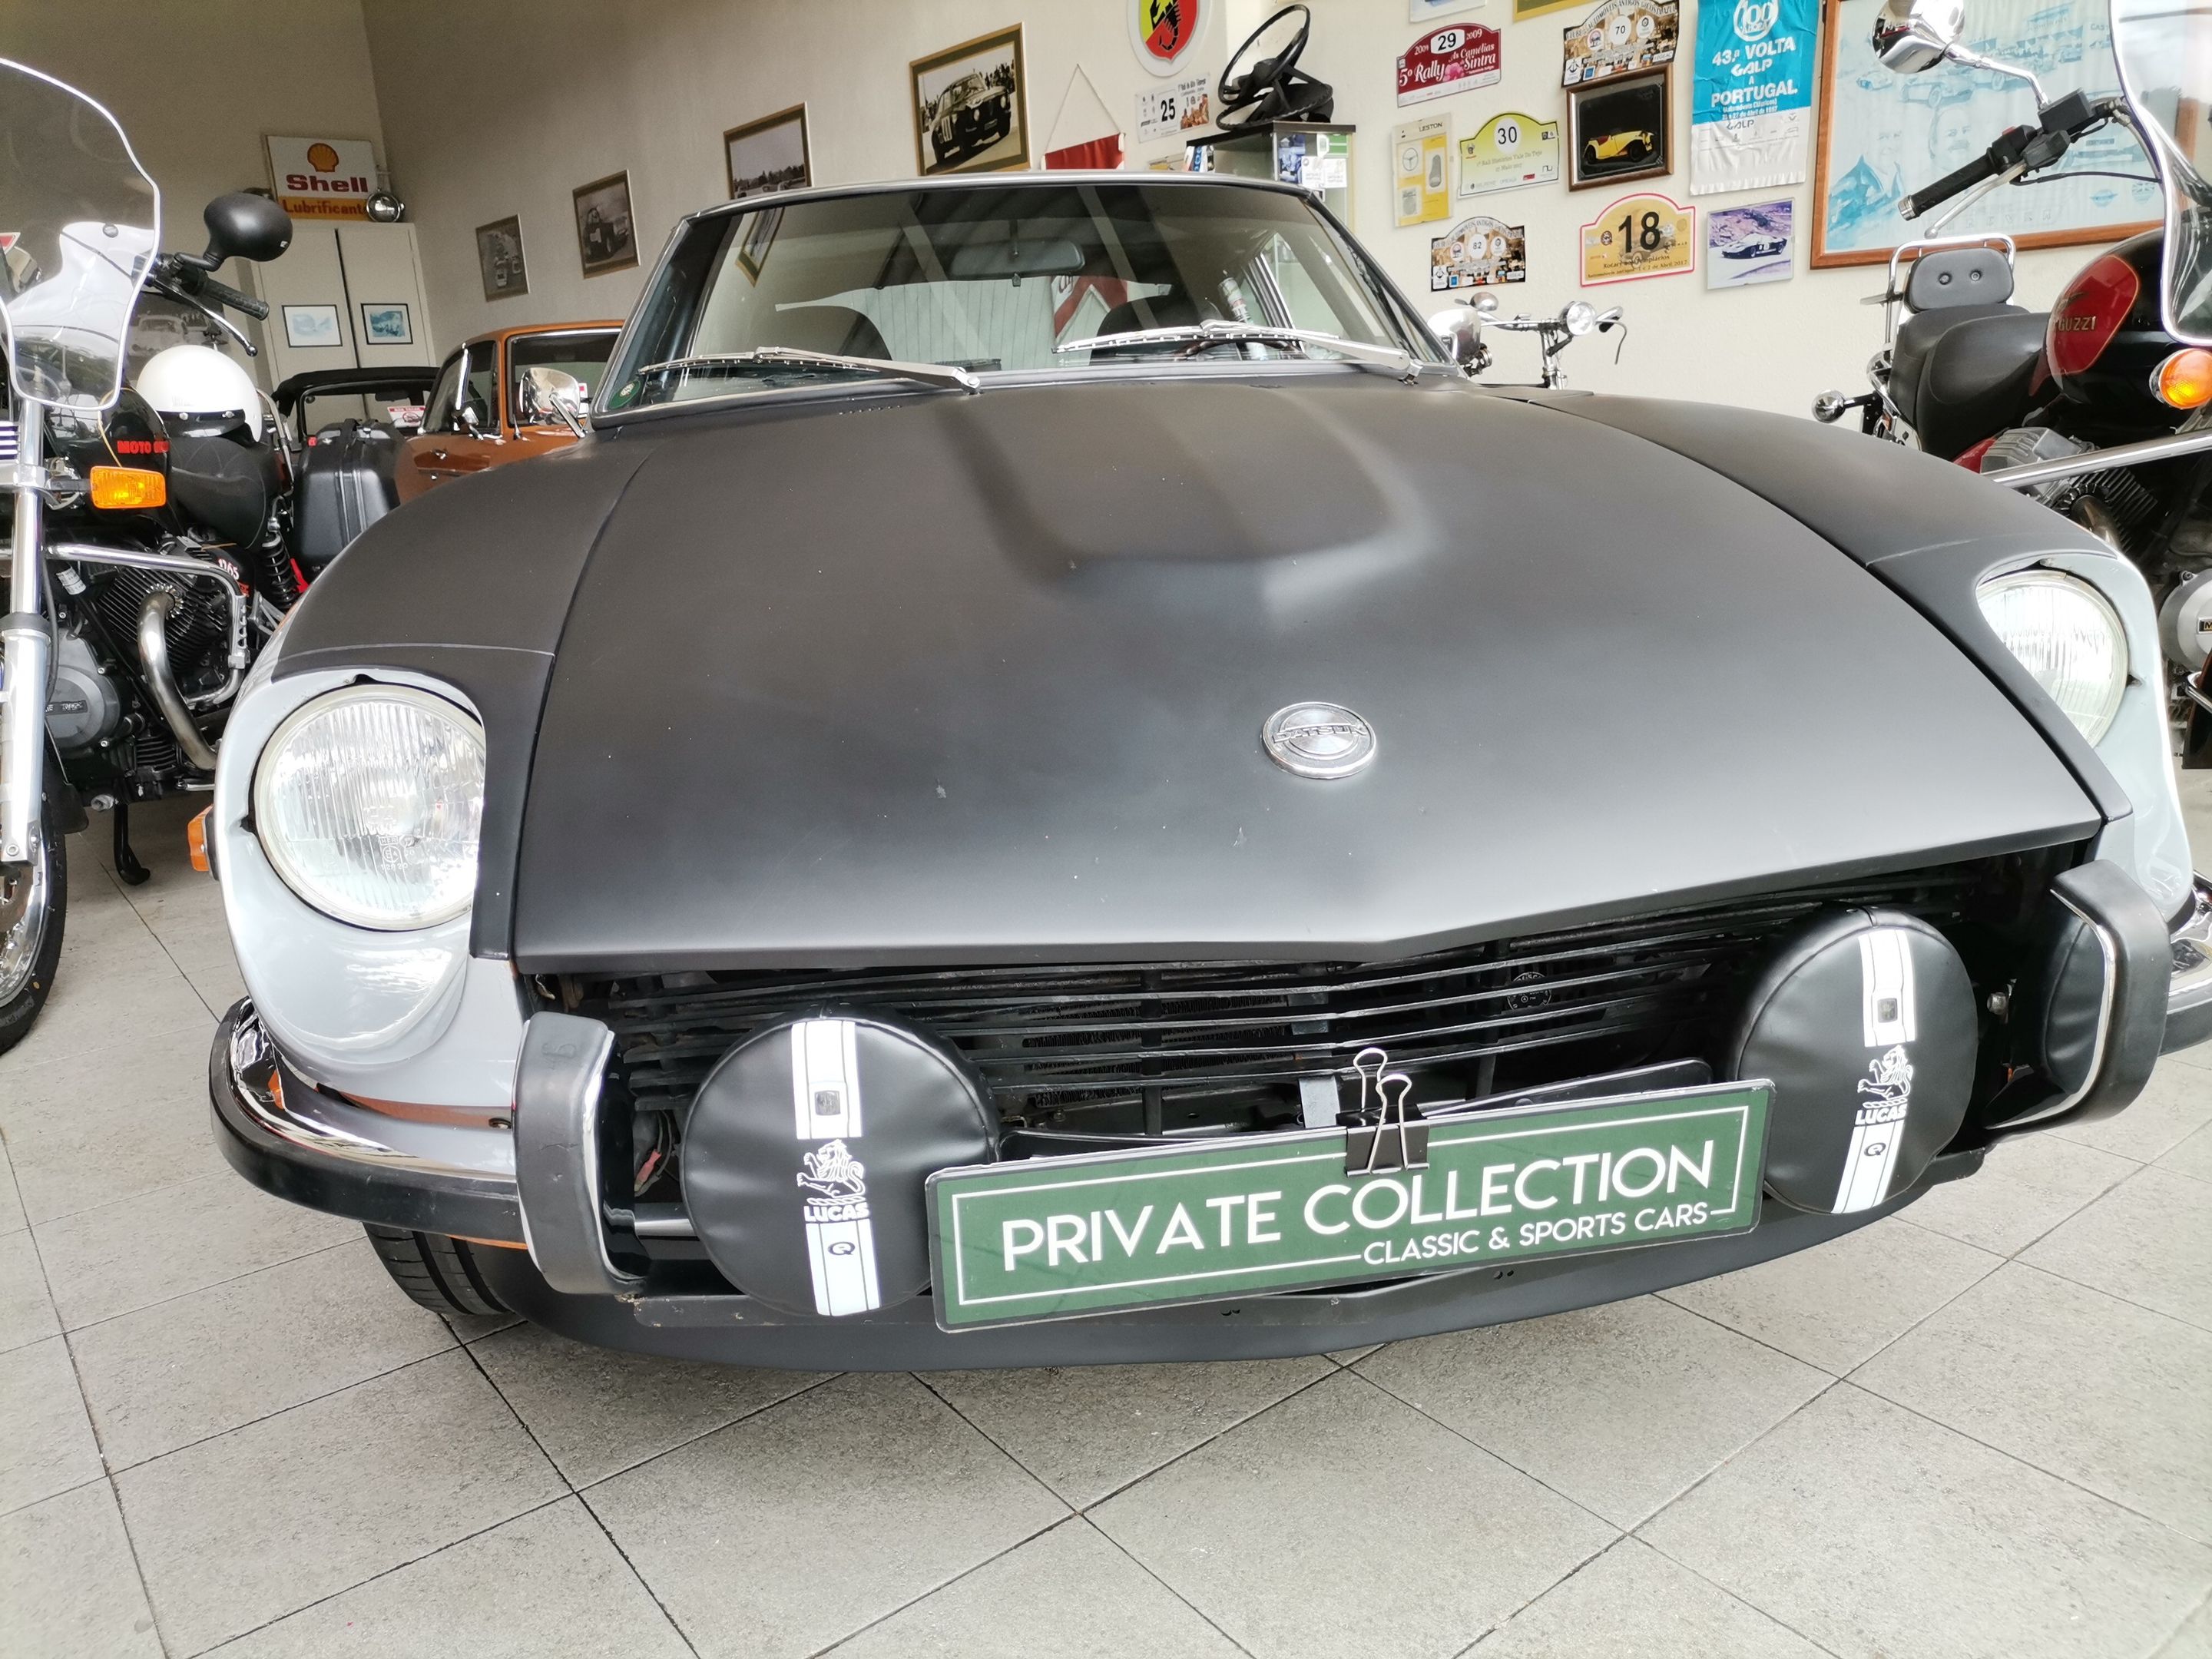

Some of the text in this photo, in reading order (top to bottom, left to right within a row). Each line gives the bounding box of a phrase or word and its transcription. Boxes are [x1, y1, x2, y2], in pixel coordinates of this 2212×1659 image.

[1615, 25, 1626, 35] 70
[1438, 32, 1456, 51] 29
[1460, 43, 1495, 59] Camélias
[1744, 36, 1796, 60] VOLTA
[1414, 59, 1445, 83] Rally
[1463, 53, 1496, 70] Sintra
[1730, 58, 1773, 77] GALP
[1711, 79, 1798, 108] PORTUGAL
[1161, 98, 1175, 122] 25
[1419, 122, 1442, 132] LESTON
[1498, 126, 1517, 144] 30
[286, 174, 368, 193] Shell
[282, 199, 367, 215] Lubrificant
[1618, 211, 1661, 253] 18
[2058, 316, 2096, 331] GUZZI
[117, 441, 152, 454] MOTO
[1272, 724, 1367, 743] DATSUN
[1855, 1103, 1907, 1126] LUCAS
[803, 1202, 870, 1222] LUCAS
[1002, 1140, 1714, 1272] PRIVATE COLLECTION
[1363, 1200, 1708, 1266] CLASSIC & SPORTS CARS
